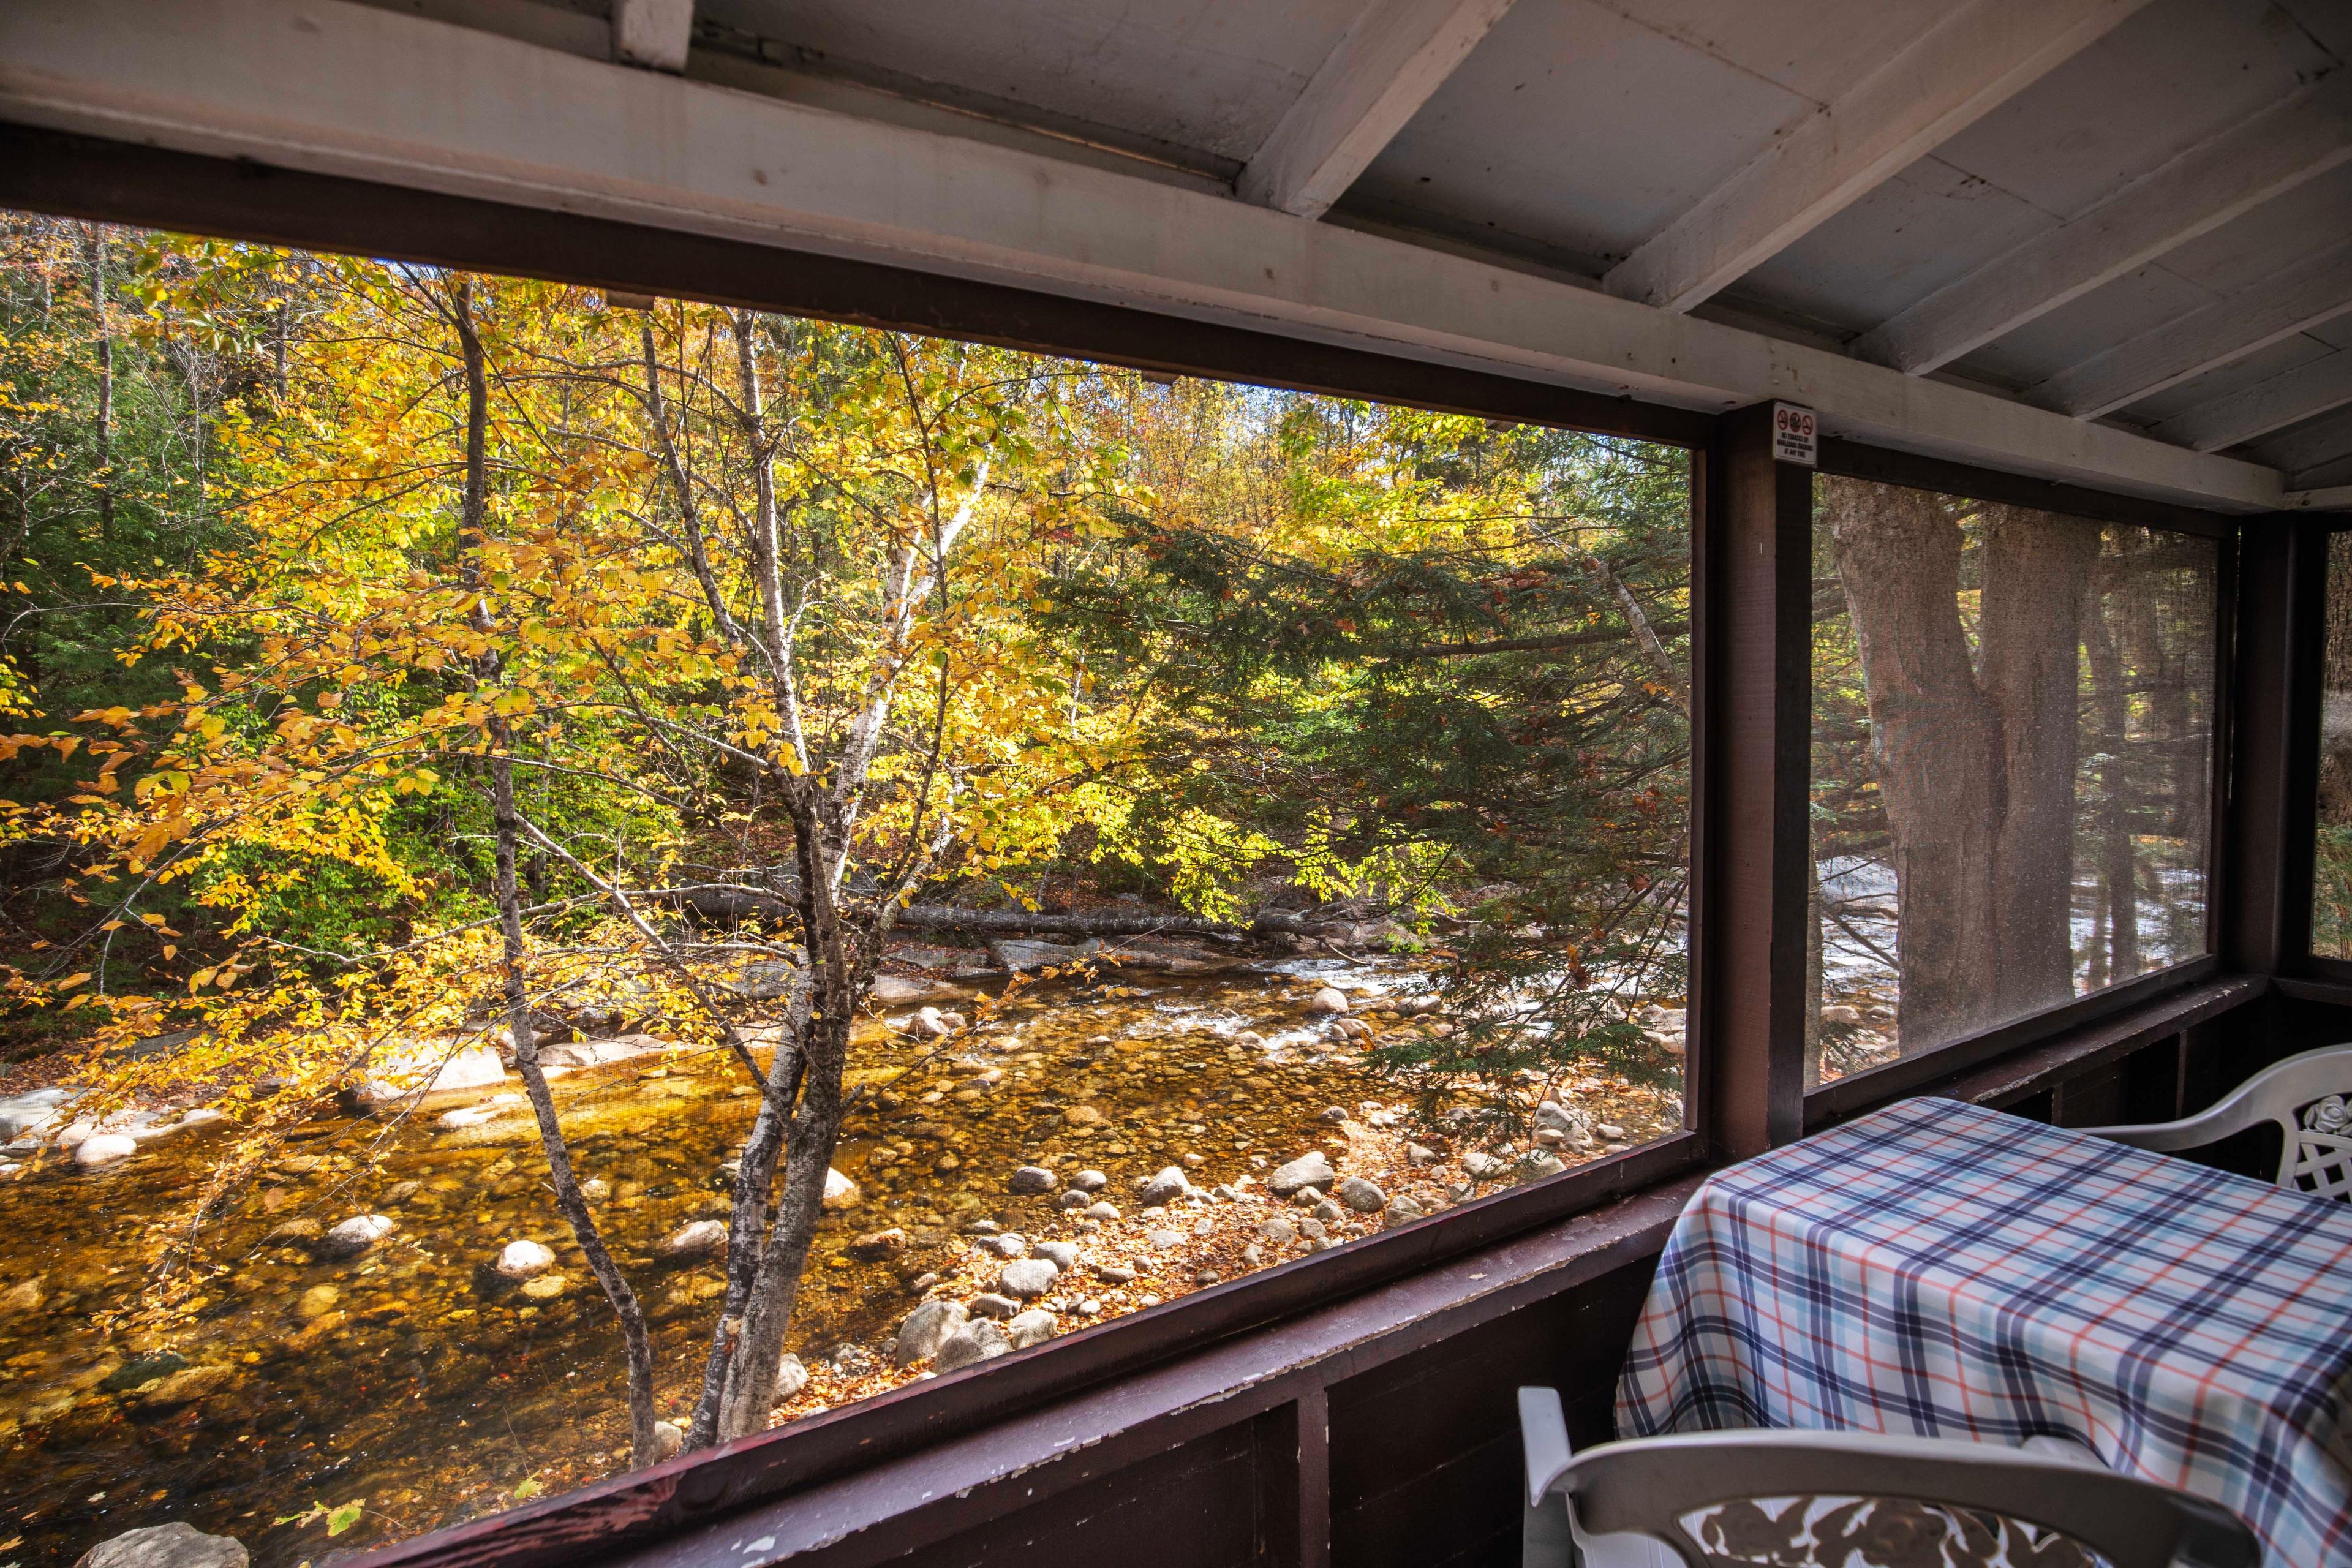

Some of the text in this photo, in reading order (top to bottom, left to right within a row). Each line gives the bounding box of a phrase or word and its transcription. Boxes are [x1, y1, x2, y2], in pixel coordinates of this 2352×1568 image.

[1788, 433, 1803, 442] TOBACCO
[1777, 439, 1814, 451] MARIJUANA SMOKING
